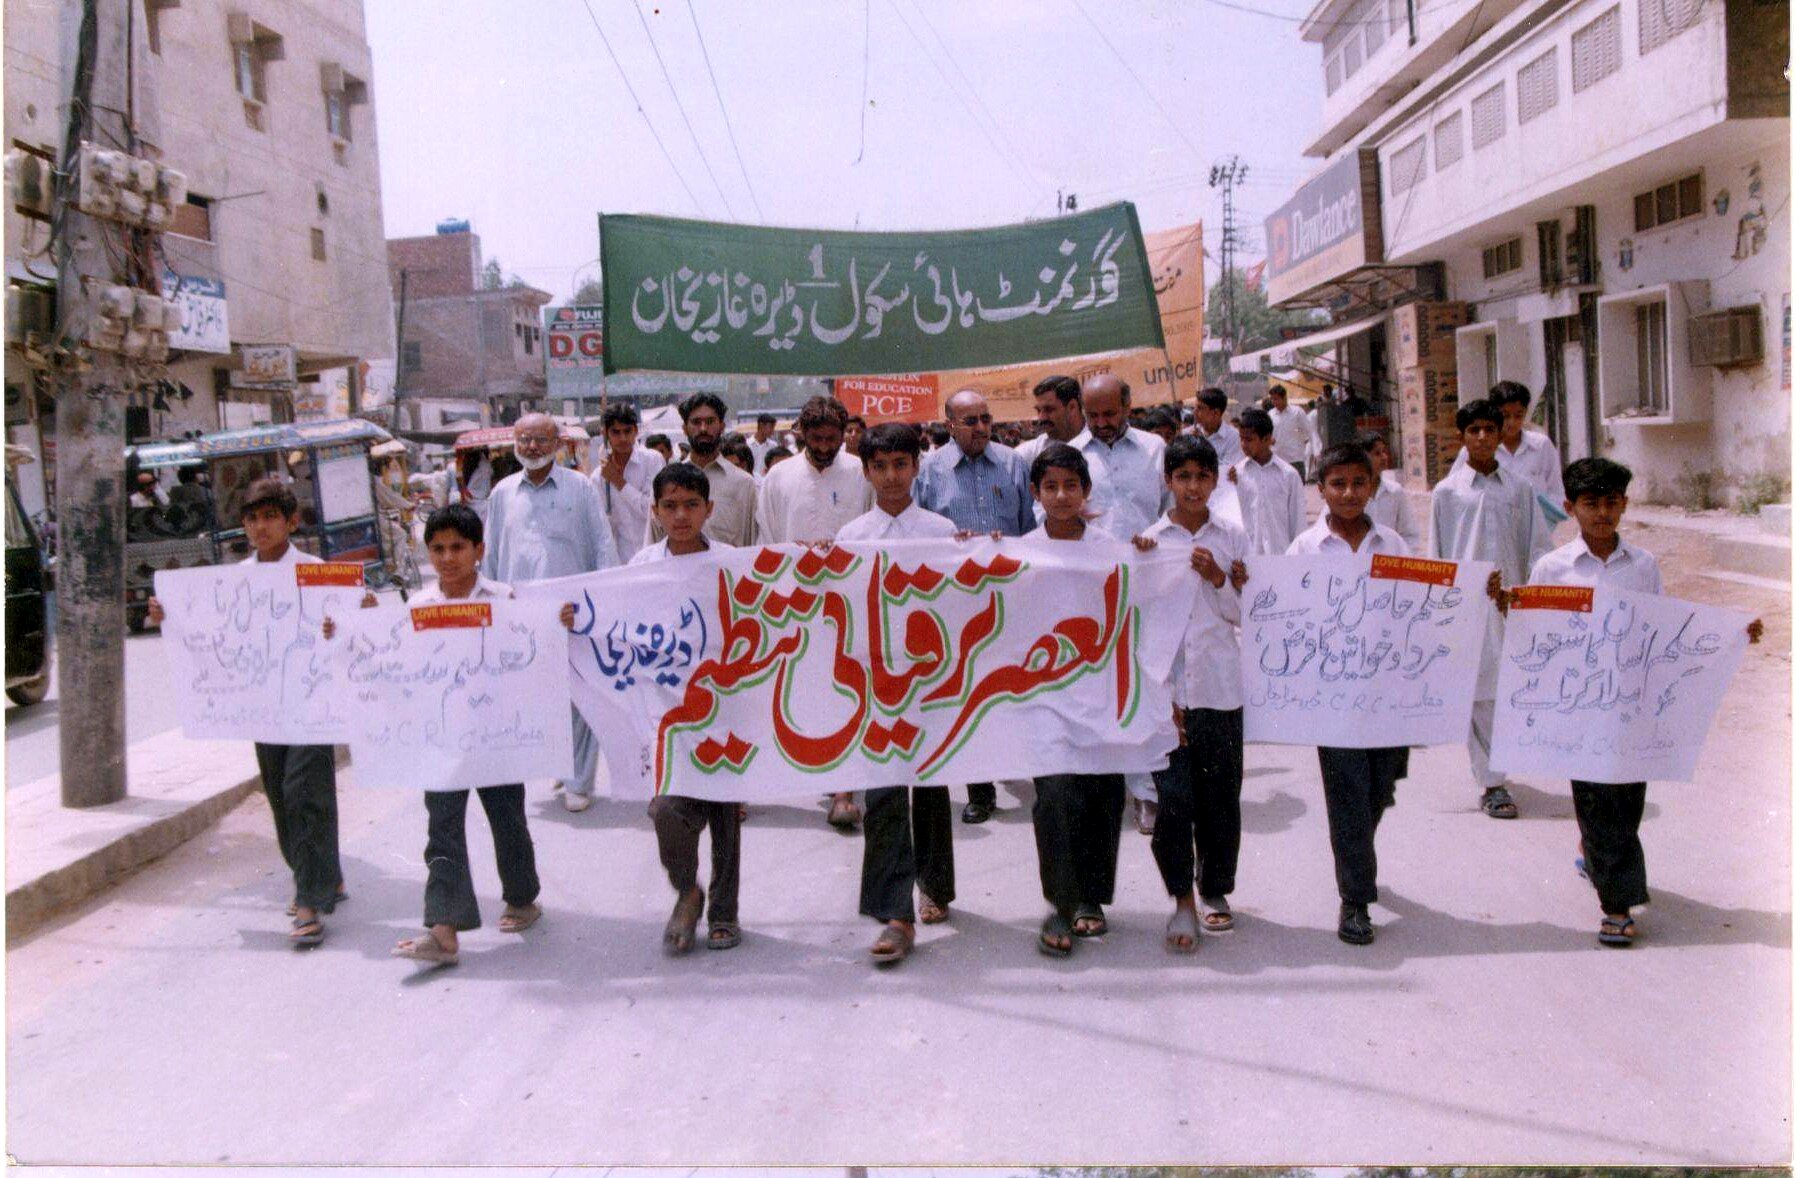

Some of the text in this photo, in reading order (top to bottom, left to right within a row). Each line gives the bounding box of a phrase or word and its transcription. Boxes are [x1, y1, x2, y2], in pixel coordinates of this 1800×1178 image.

[1291, 189, 1357, 262] Dawlance
[810, 257, 909, 345] سکول
[976, 228, 1127, 322] گورنمنٹ
[549, 332, 604, 358] DG
[751, 278, 804, 350] ڈیرہ
[843, 381, 933, 396] FOR EDUCATION
[861, 394, 913, 417] PCE
[297, 564, 361, 577] LOVE HUMANITY
[1373, 556, 1454, 574] LOVE HUMANITY
[1516, 587, 1592, 600] OVE HUMANITY
[412, 603, 489, 620] LOVE HUMANITY
[442, 621, 537, 733] تعلیم
[655, 547, 824, 797] تنظیم
[771, 545, 1030, 774] ترقیاتی
[915, 562, 1141, 781] العصر
